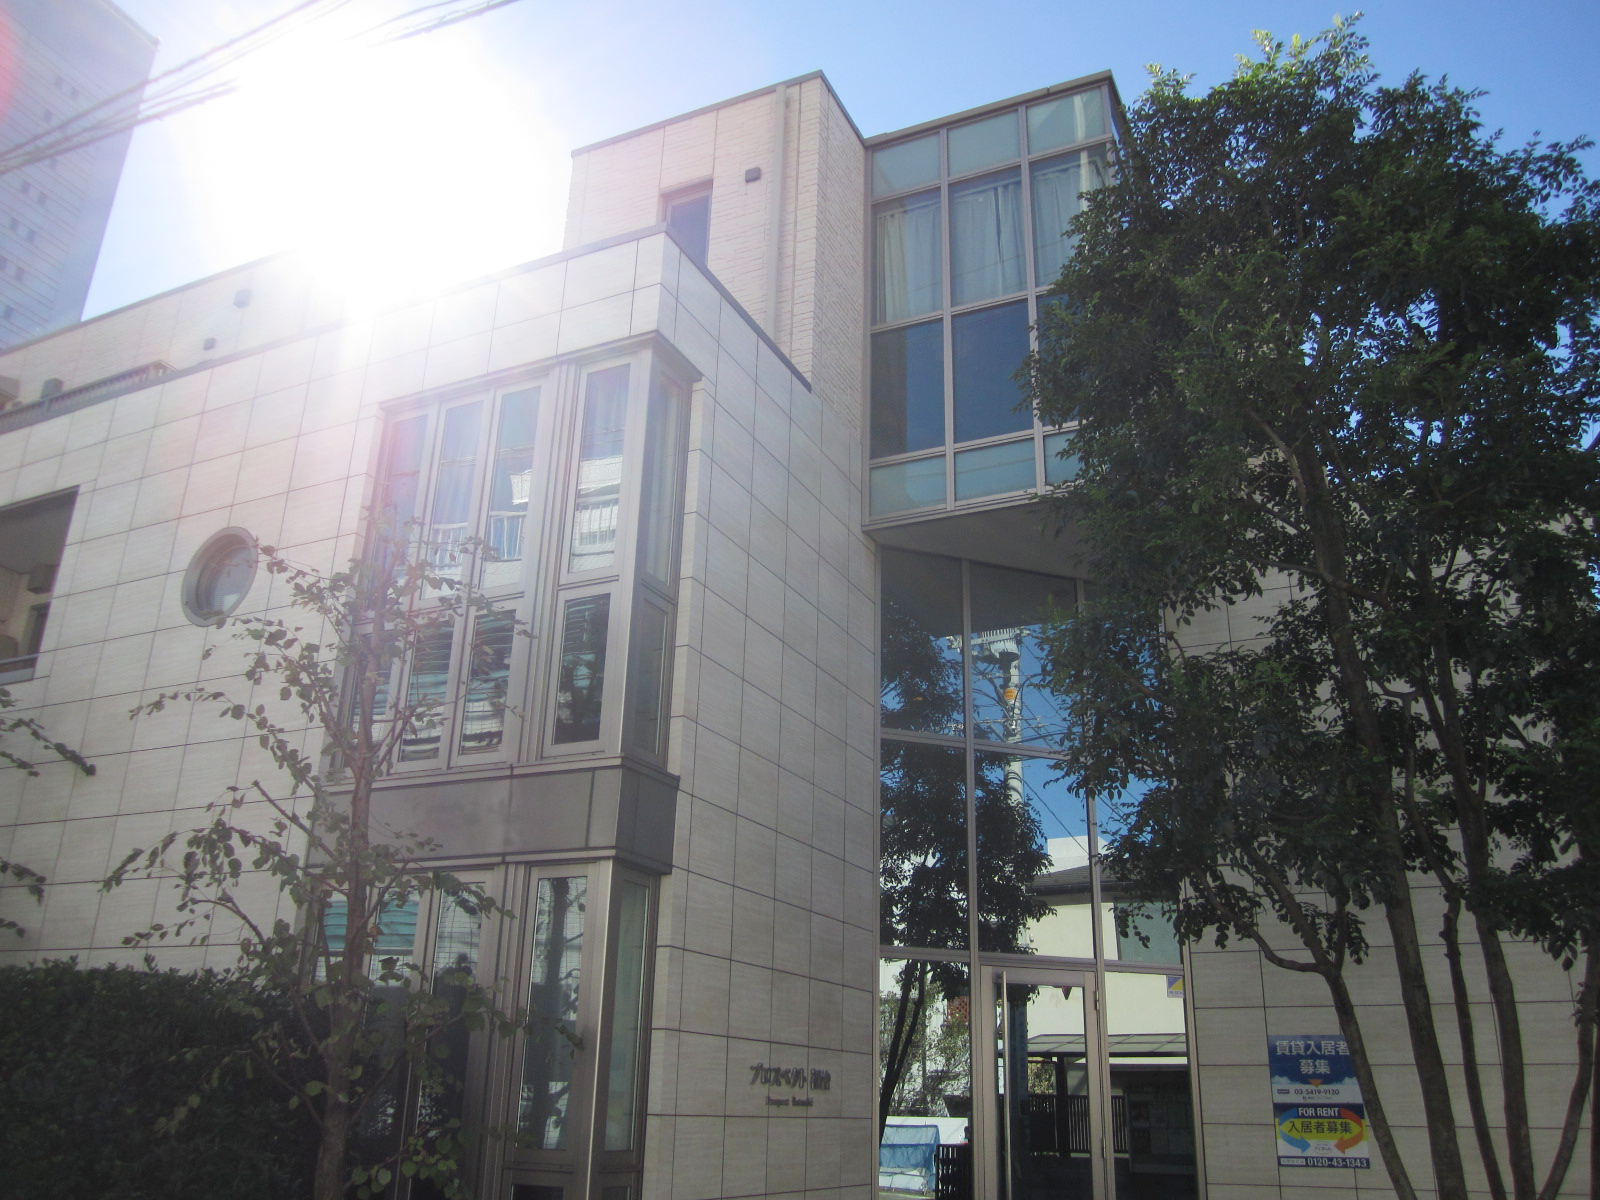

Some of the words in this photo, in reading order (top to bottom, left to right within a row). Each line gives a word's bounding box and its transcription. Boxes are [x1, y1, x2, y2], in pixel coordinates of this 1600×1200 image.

[1275, 1040, 1350, 1055] 賃貸入居者
[1299, 1059, 1331, 1074] 募集
[1298, 1107, 1315, 1116] FOR
[1317, 1107, 1339, 1117] RENT
[1288, 1120, 1352, 1134] 入居者募集
[1307, 1157, 1367, 1168] 0120-43-1343
